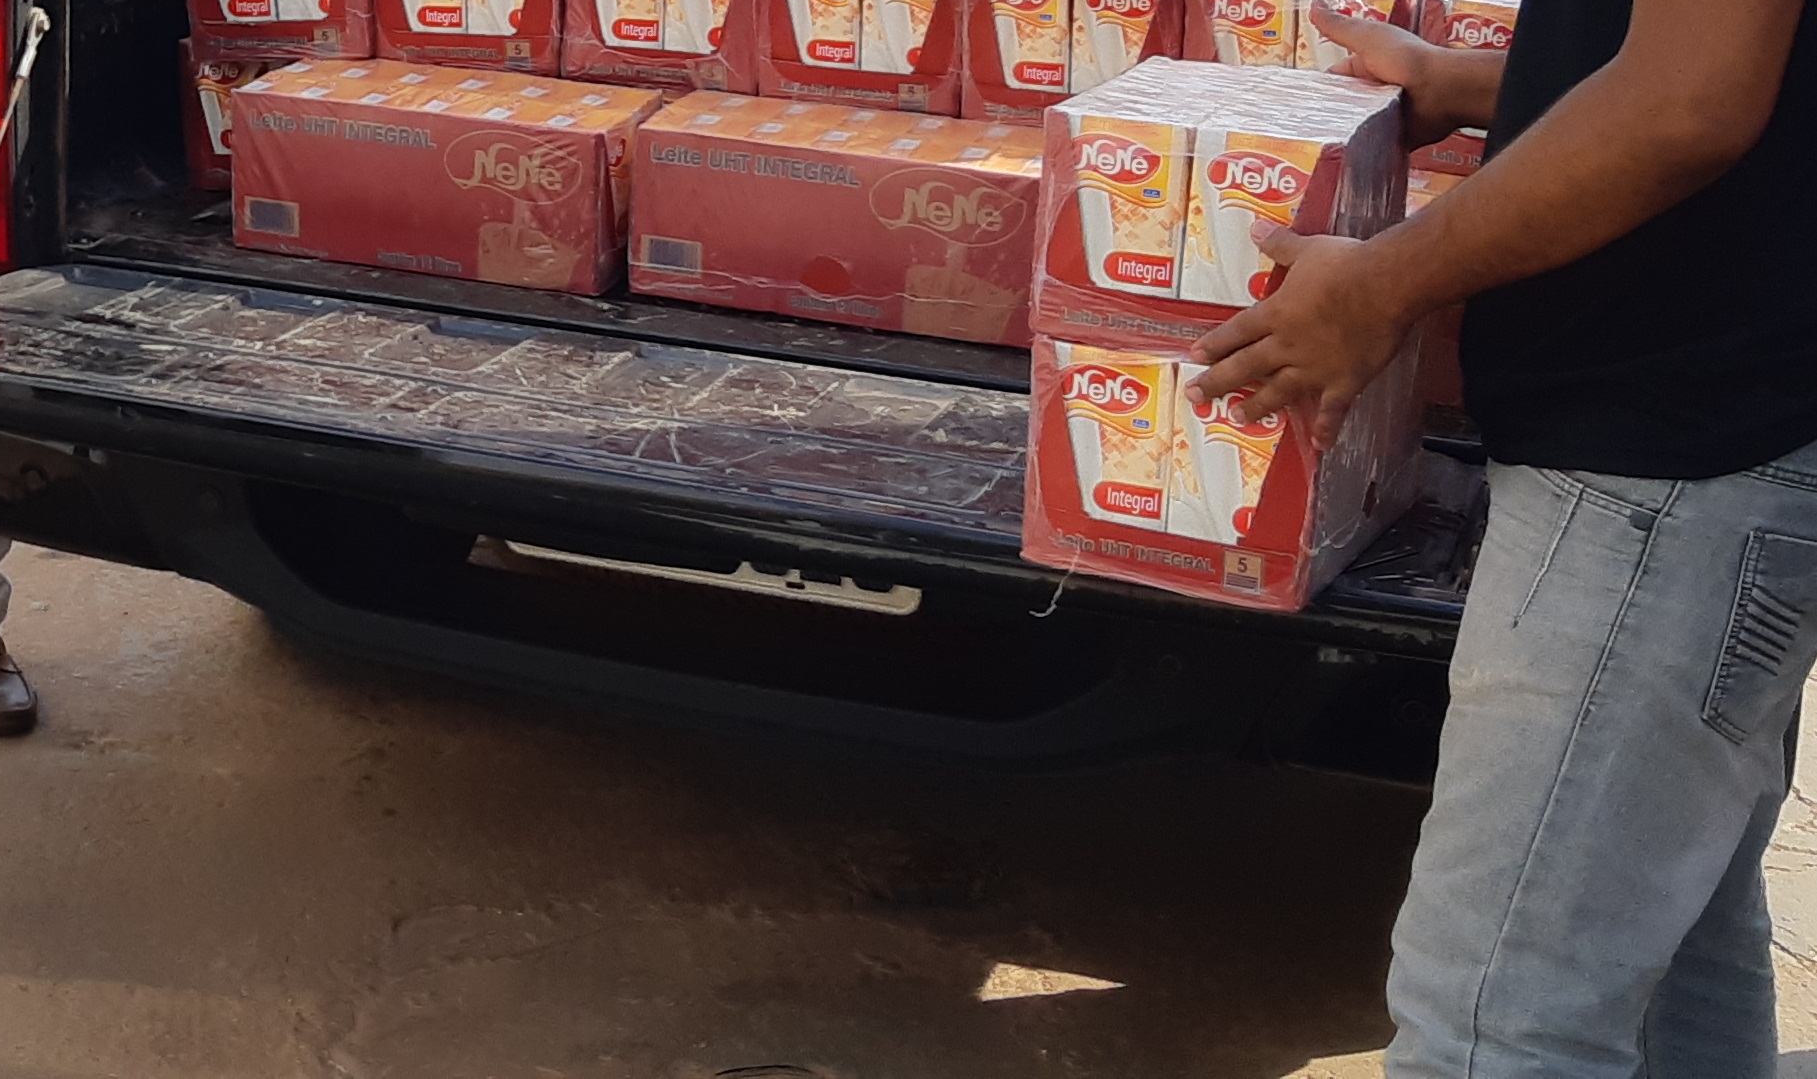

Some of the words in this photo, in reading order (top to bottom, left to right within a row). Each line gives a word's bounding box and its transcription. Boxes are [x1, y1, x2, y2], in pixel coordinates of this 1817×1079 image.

[425, 8, 460, 27] Integral
[321, 30, 329, 42] 5
[621, 22, 657, 40] Integral
[514, 43, 522, 56] 5
[815, 42, 853, 62] Integral
[1023, 65, 1062, 85] Integral
[249, 110, 297, 132] Leite
[301, 115, 340, 135] UHT
[344, 120, 437, 150] INTEGRAL
[650, 141, 703, 167] Leite
[708, 148, 751, 172] UHT
[754, 155, 862, 188] INTEGRAL
[1117, 256, 1171, 284] Integral
[1106, 487, 1160, 512] Integral
[1135, 545, 1216, 573] INTEGRAL
[1237, 557, 1248, 573] 5
